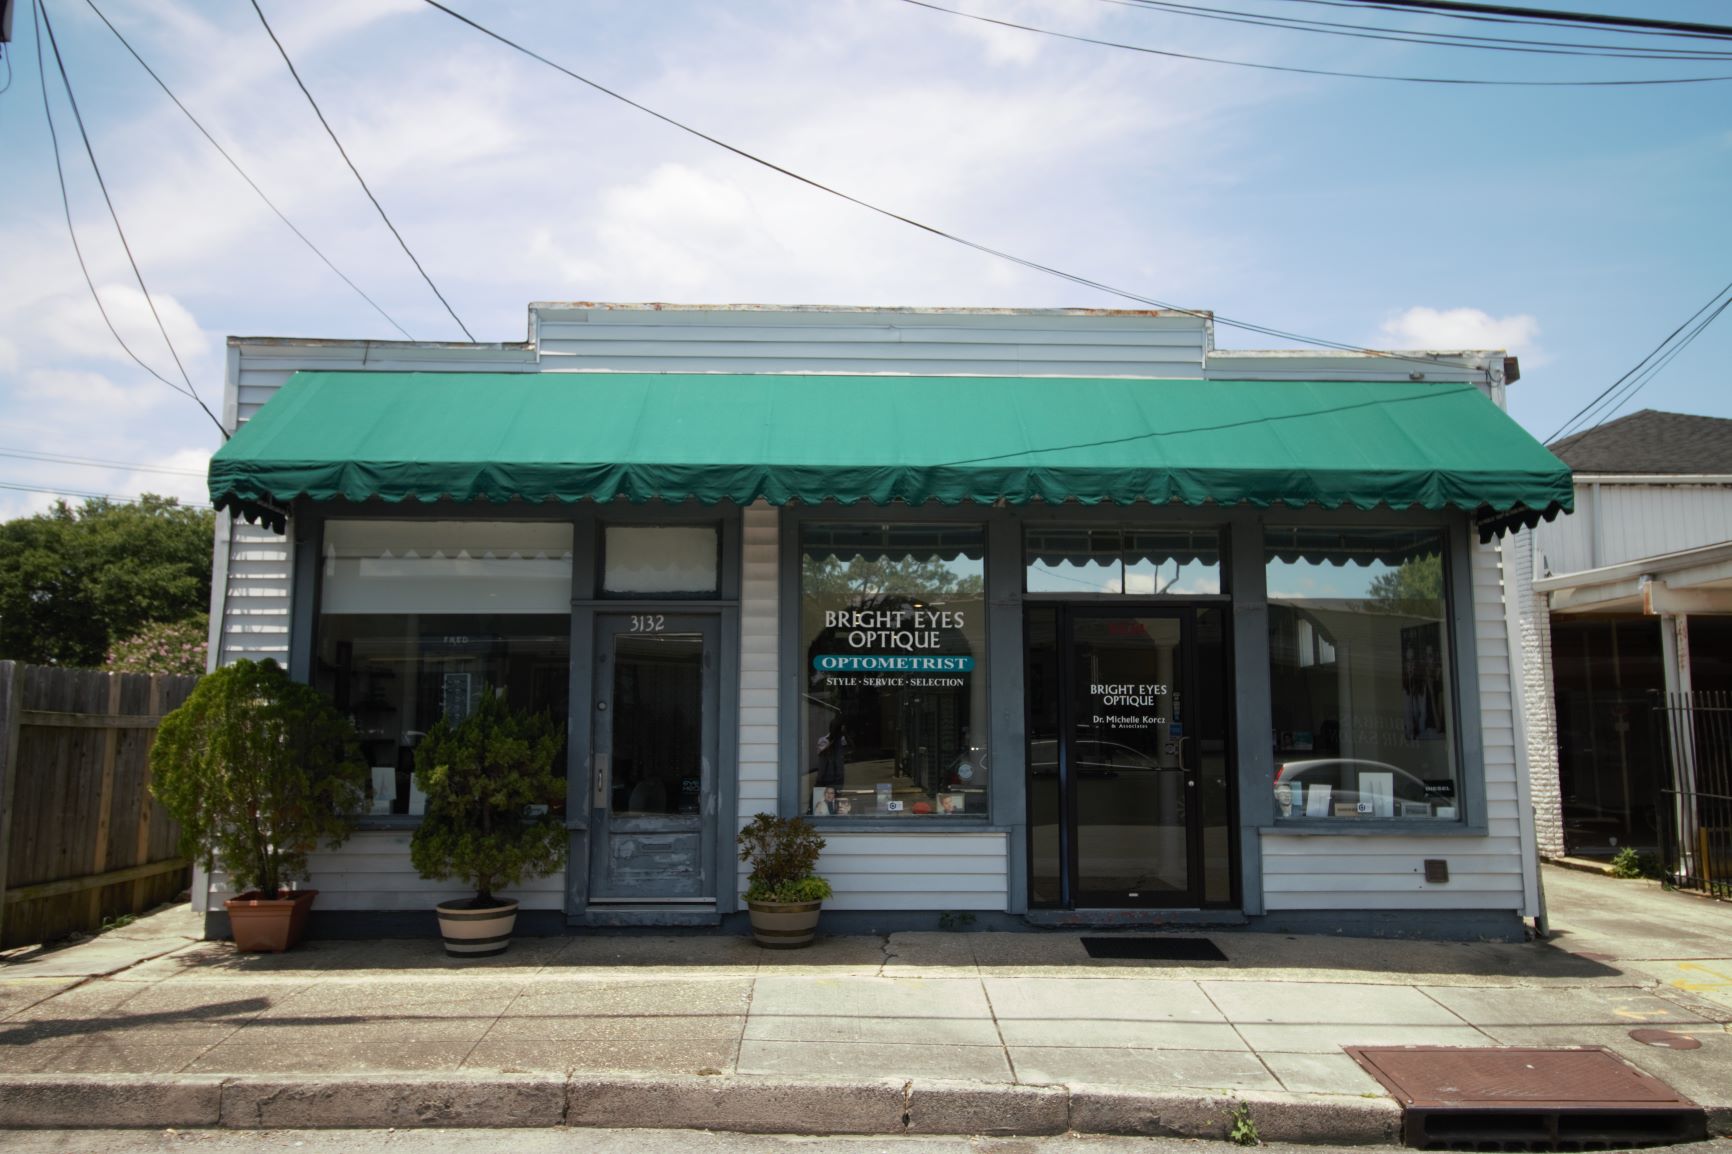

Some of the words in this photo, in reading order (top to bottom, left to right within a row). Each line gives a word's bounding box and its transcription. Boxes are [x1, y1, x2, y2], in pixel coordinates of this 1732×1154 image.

[629, 614, 665, 632] 3132
[825, 611, 906, 628] BRIGHT
[915, 611, 965, 629] EYES
[848, 630, 941, 651] OPTIQUE
[821, 657, 968, 669] OPTOMETRIST
[826, 677, 857, 686] STYLE
[863, 677, 904, 687] SERVICE
[910, 677, 964, 687] SELECTION
[1090, 684, 1135, 695] BRIGHT
[1139, 684, 1167, 695] EYES
[1103, 695, 1154, 707] OPTIQUE
[1093, 715, 1104, 724] Dr.
[1106, 715, 1140, 724] Michelle
[1142, 715, 1166, 724] Korcz
